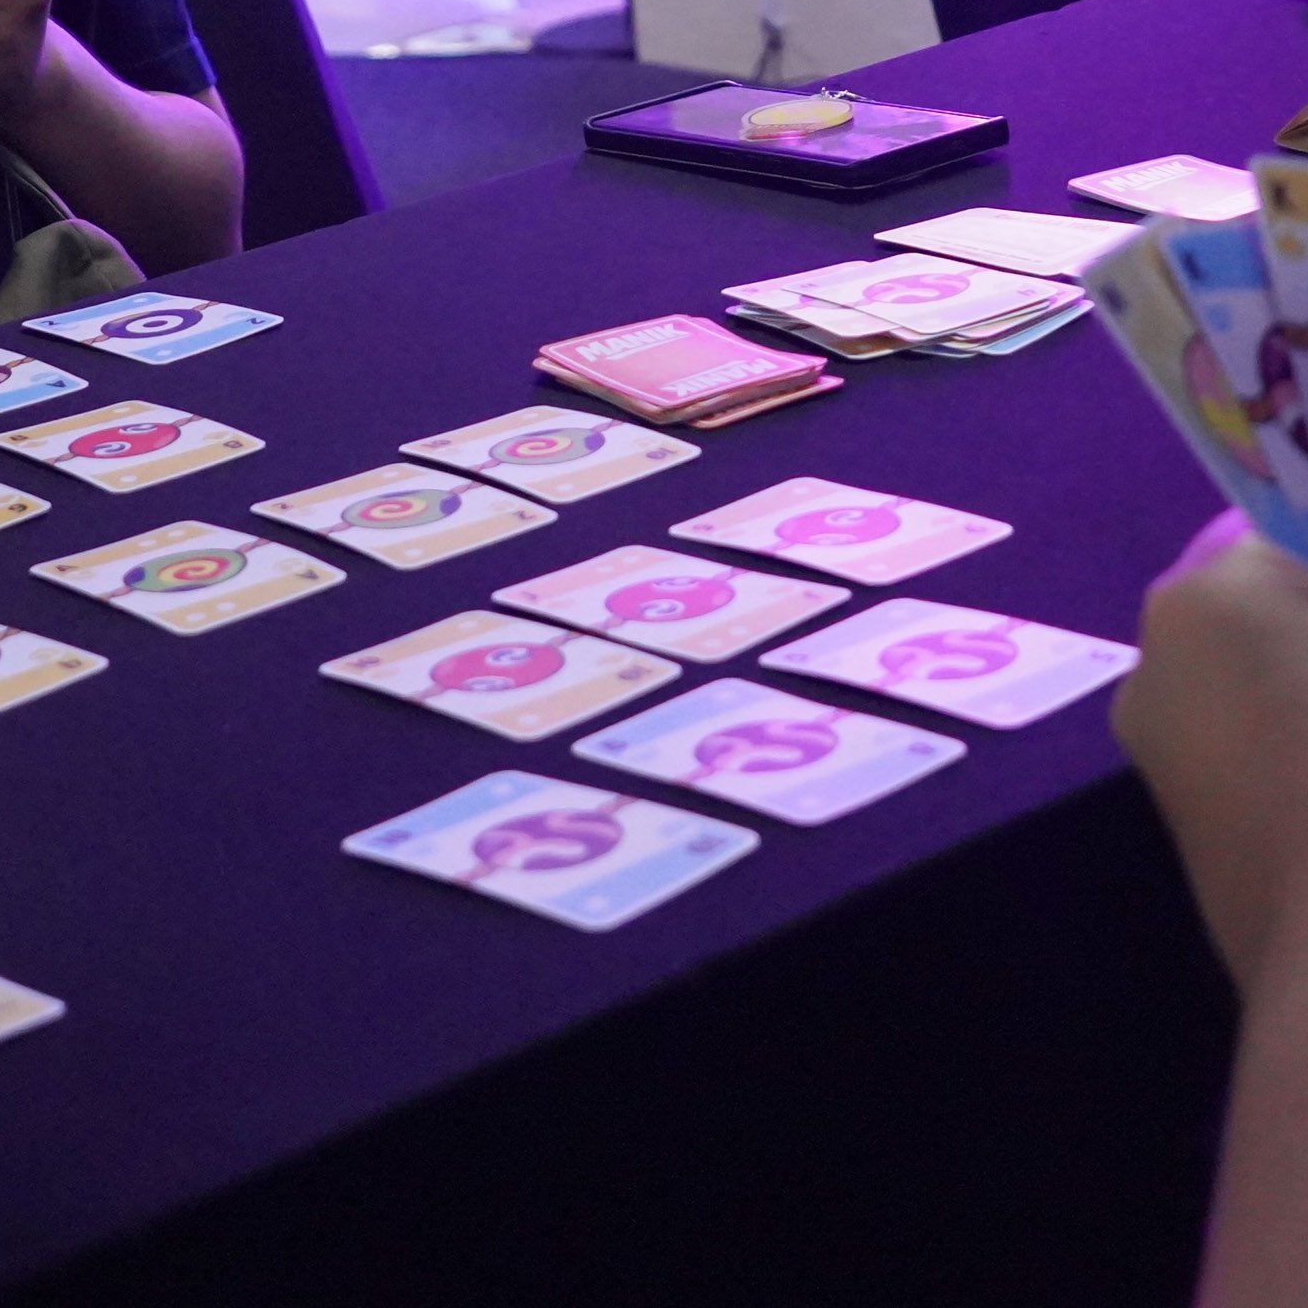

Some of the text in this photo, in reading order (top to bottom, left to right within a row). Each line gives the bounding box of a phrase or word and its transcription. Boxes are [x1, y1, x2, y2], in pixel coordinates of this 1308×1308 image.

[1101, 161, 1193, 193] MANIK
[575, 323, 688, 361] MANIK
[661, 358, 779, 397] MANIK
